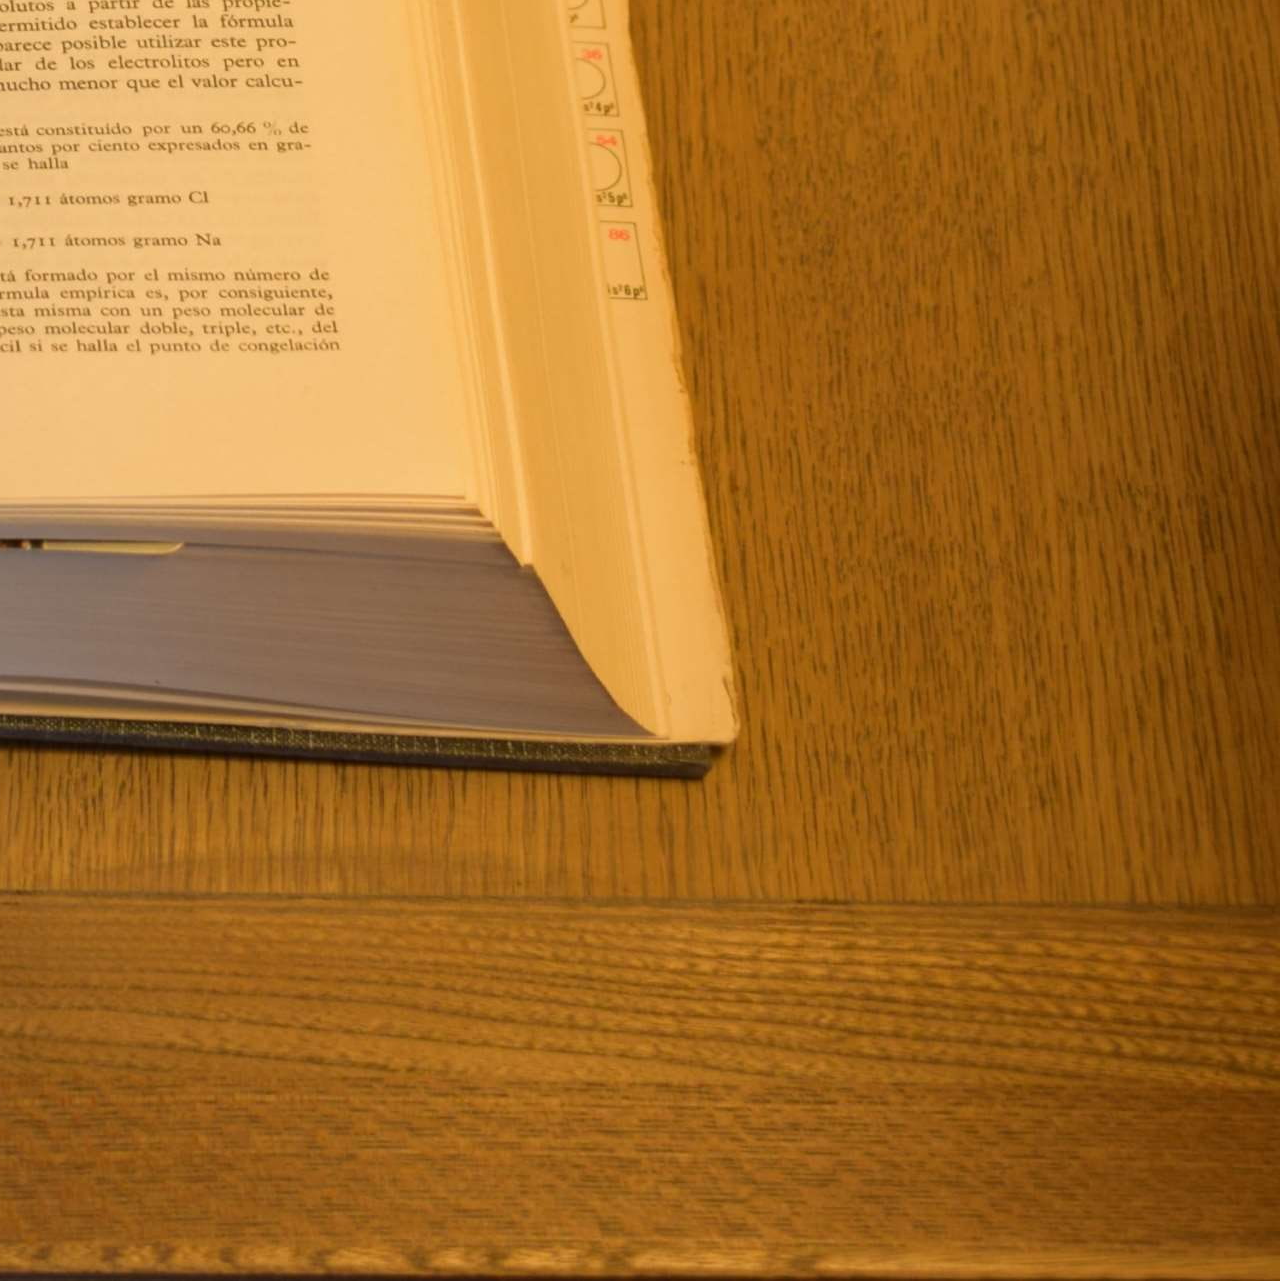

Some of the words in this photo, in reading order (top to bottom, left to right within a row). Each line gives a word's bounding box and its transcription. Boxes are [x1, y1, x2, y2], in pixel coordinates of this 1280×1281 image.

[59, 192, 121, 207] átomos
[127, 193, 183, 208] gramo
[188, 190, 209, 205] Cl
[24, 269, 99, 283] formado
[106, 270, 136, 287] por
[144, 269, 159, 282] el
[167, 269, 225, 282] mismo
[233, 269, 301, 282] número
[308, 268, 330, 281] de
